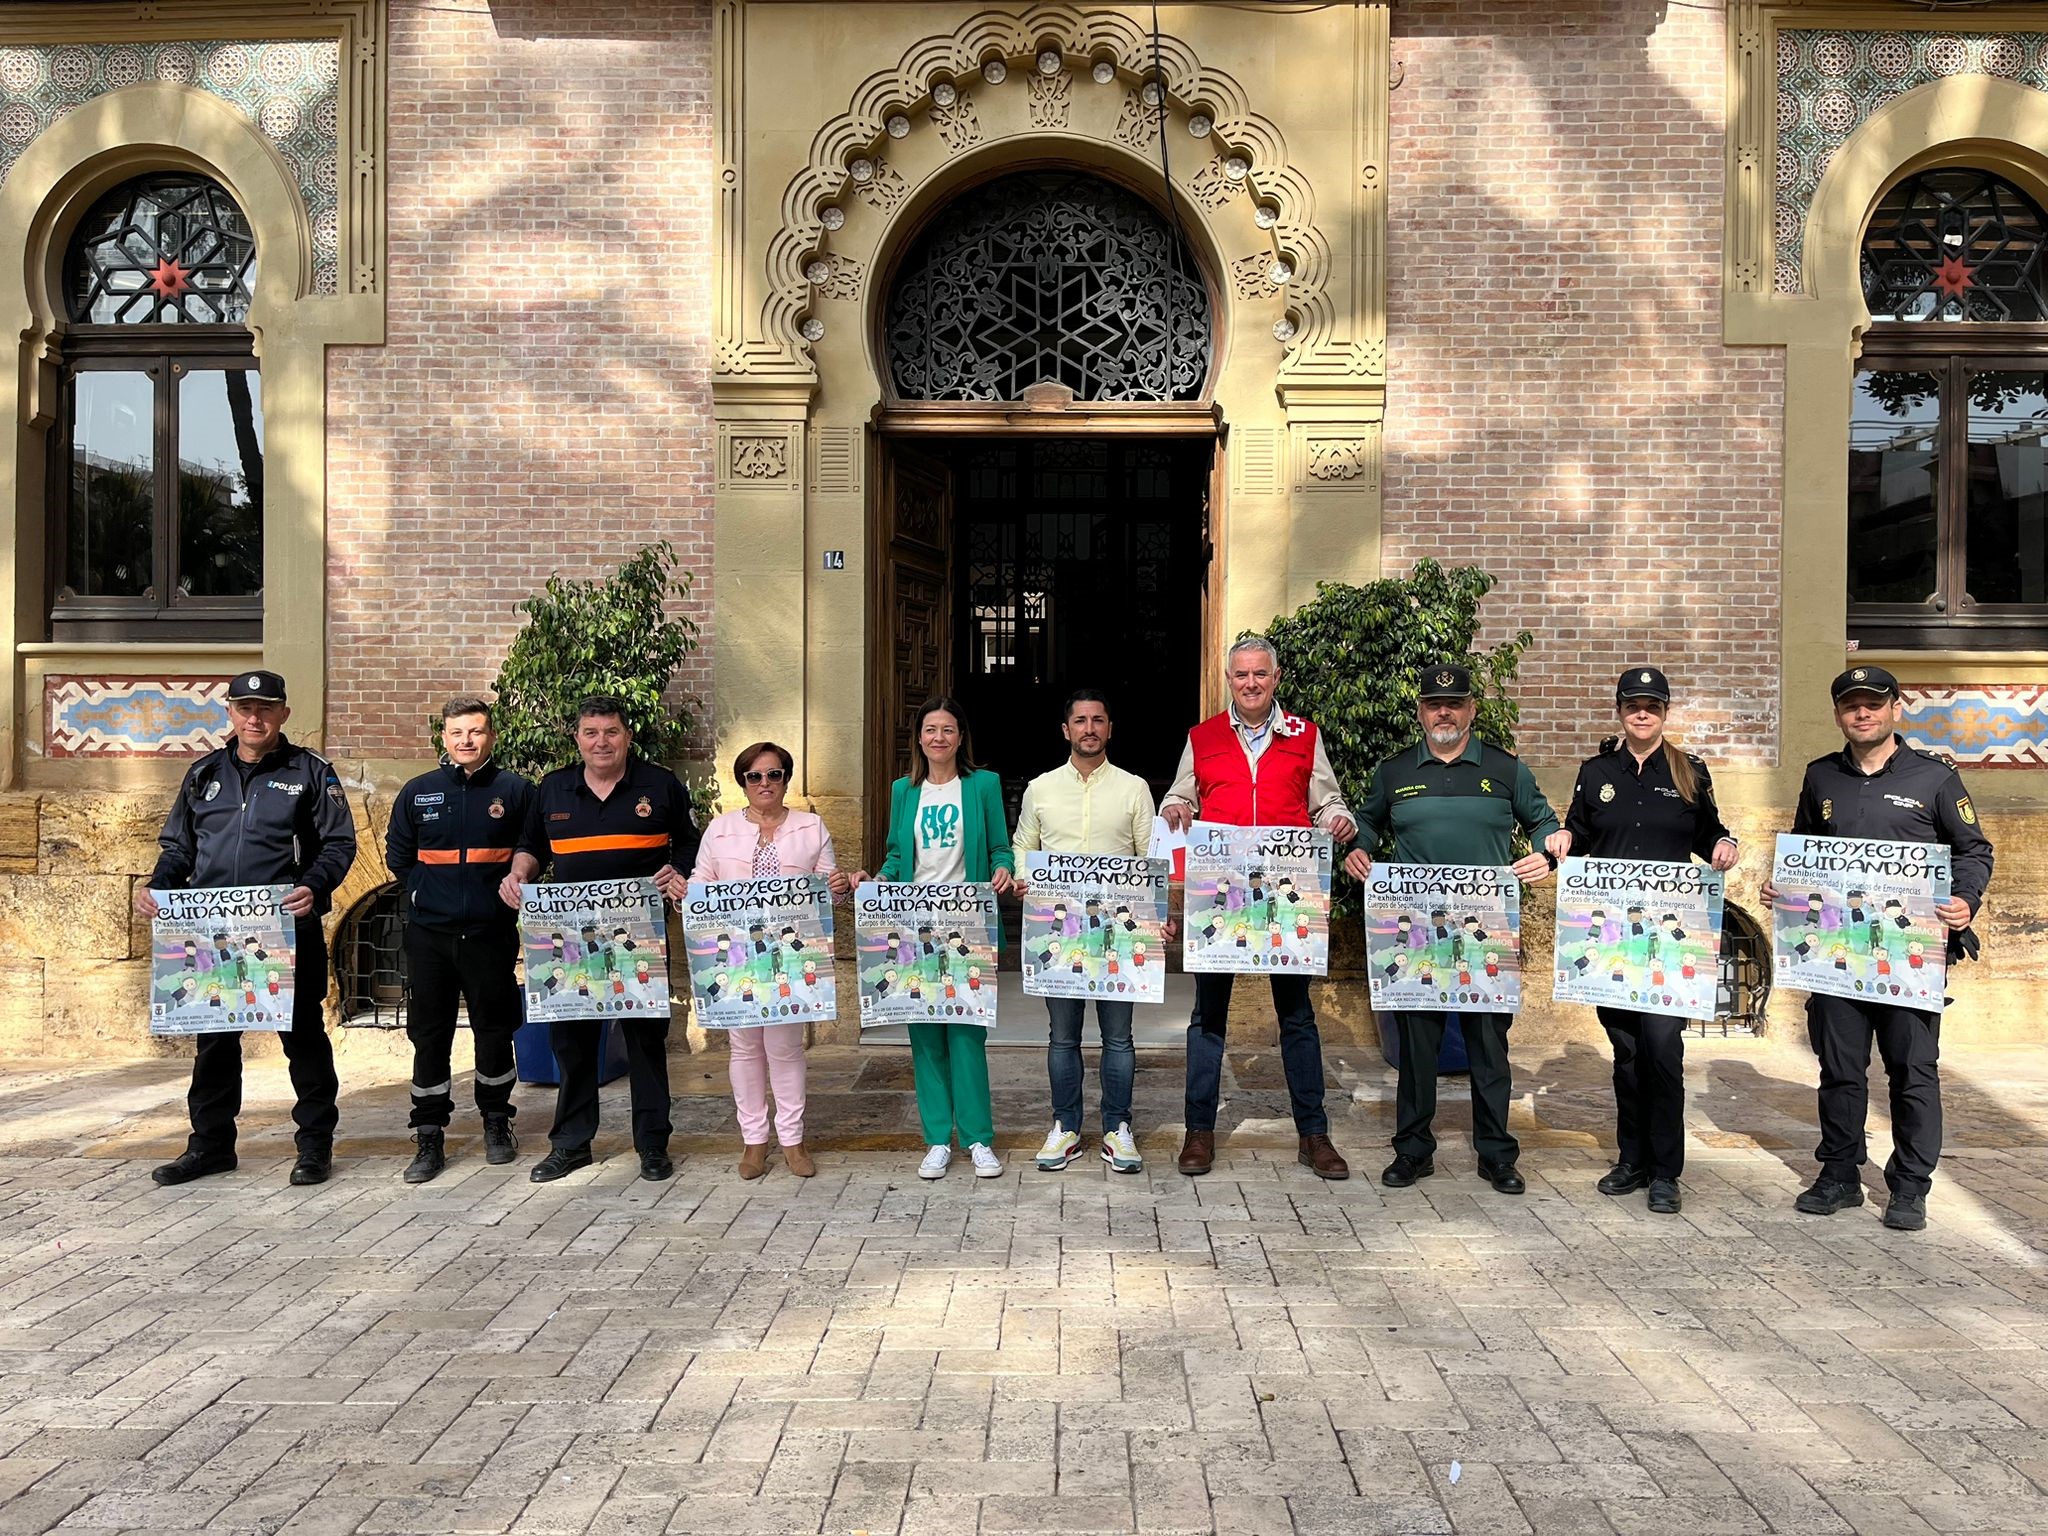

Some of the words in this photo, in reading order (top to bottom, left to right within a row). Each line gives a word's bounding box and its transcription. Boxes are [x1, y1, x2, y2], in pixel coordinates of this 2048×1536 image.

[826, 552, 842, 568] 14
[273, 782, 303, 793] POLICÍA
[1394, 786, 1412, 794] GUARDIA
[417, 795, 442, 803] TÉCNICO
[1209, 828, 1312, 842] PROYECTO
[1805, 839, 1928, 860] PROYECTO
[1049, 854, 1149, 872] PROYECTO
[1277, 865, 1308, 873] Emergencias
[1585, 861, 1701, 879] PROYECTO
[1784, 854, 1946, 881] CUIDÁNDOTE
[1032, 867, 1164, 888] CUIDÁNDOTE
[1389, 866, 1497, 881] PROYECTO
[1788, 869, 1828, 879] exhibición
[537, 882, 641, 899] PROYECTO
[706, 878, 810, 898] PROYECTO
[878, 885, 977, 897] PROYECTO
[1036, 882, 1070, 890] exhibición
[1372, 878, 1514, 897] CUIDÁNDOTE
[1566, 874, 1719, 896] CUIDÁNDOTE
[1776, 874, 1799, 884] Cuerpos
[1883, 884, 1921, 896] Emergencias
[169, 890, 271, 905] PROYECTO
[525, 894, 658, 913] CUIDÁNDOTE
[690, 890, 827, 914] CUIDÁNDOTE
[863, 895, 993, 913] CUIDÁNDOTE
[1114, 893, 1145, 902] Emergencias
[1660, 900, 1696, 910] Emergencias
[157, 901, 289, 920] CUIDÁNDOTE
[1461, 903, 1494, 912] Emergencias
[609, 915, 641, 924] Emergencias
[686, 922, 707, 930] Cuerpos
[778, 912, 809, 923] Emergencias
[696, 913, 731, 922] exhibición
[240, 924, 271, 932] Emergencias
